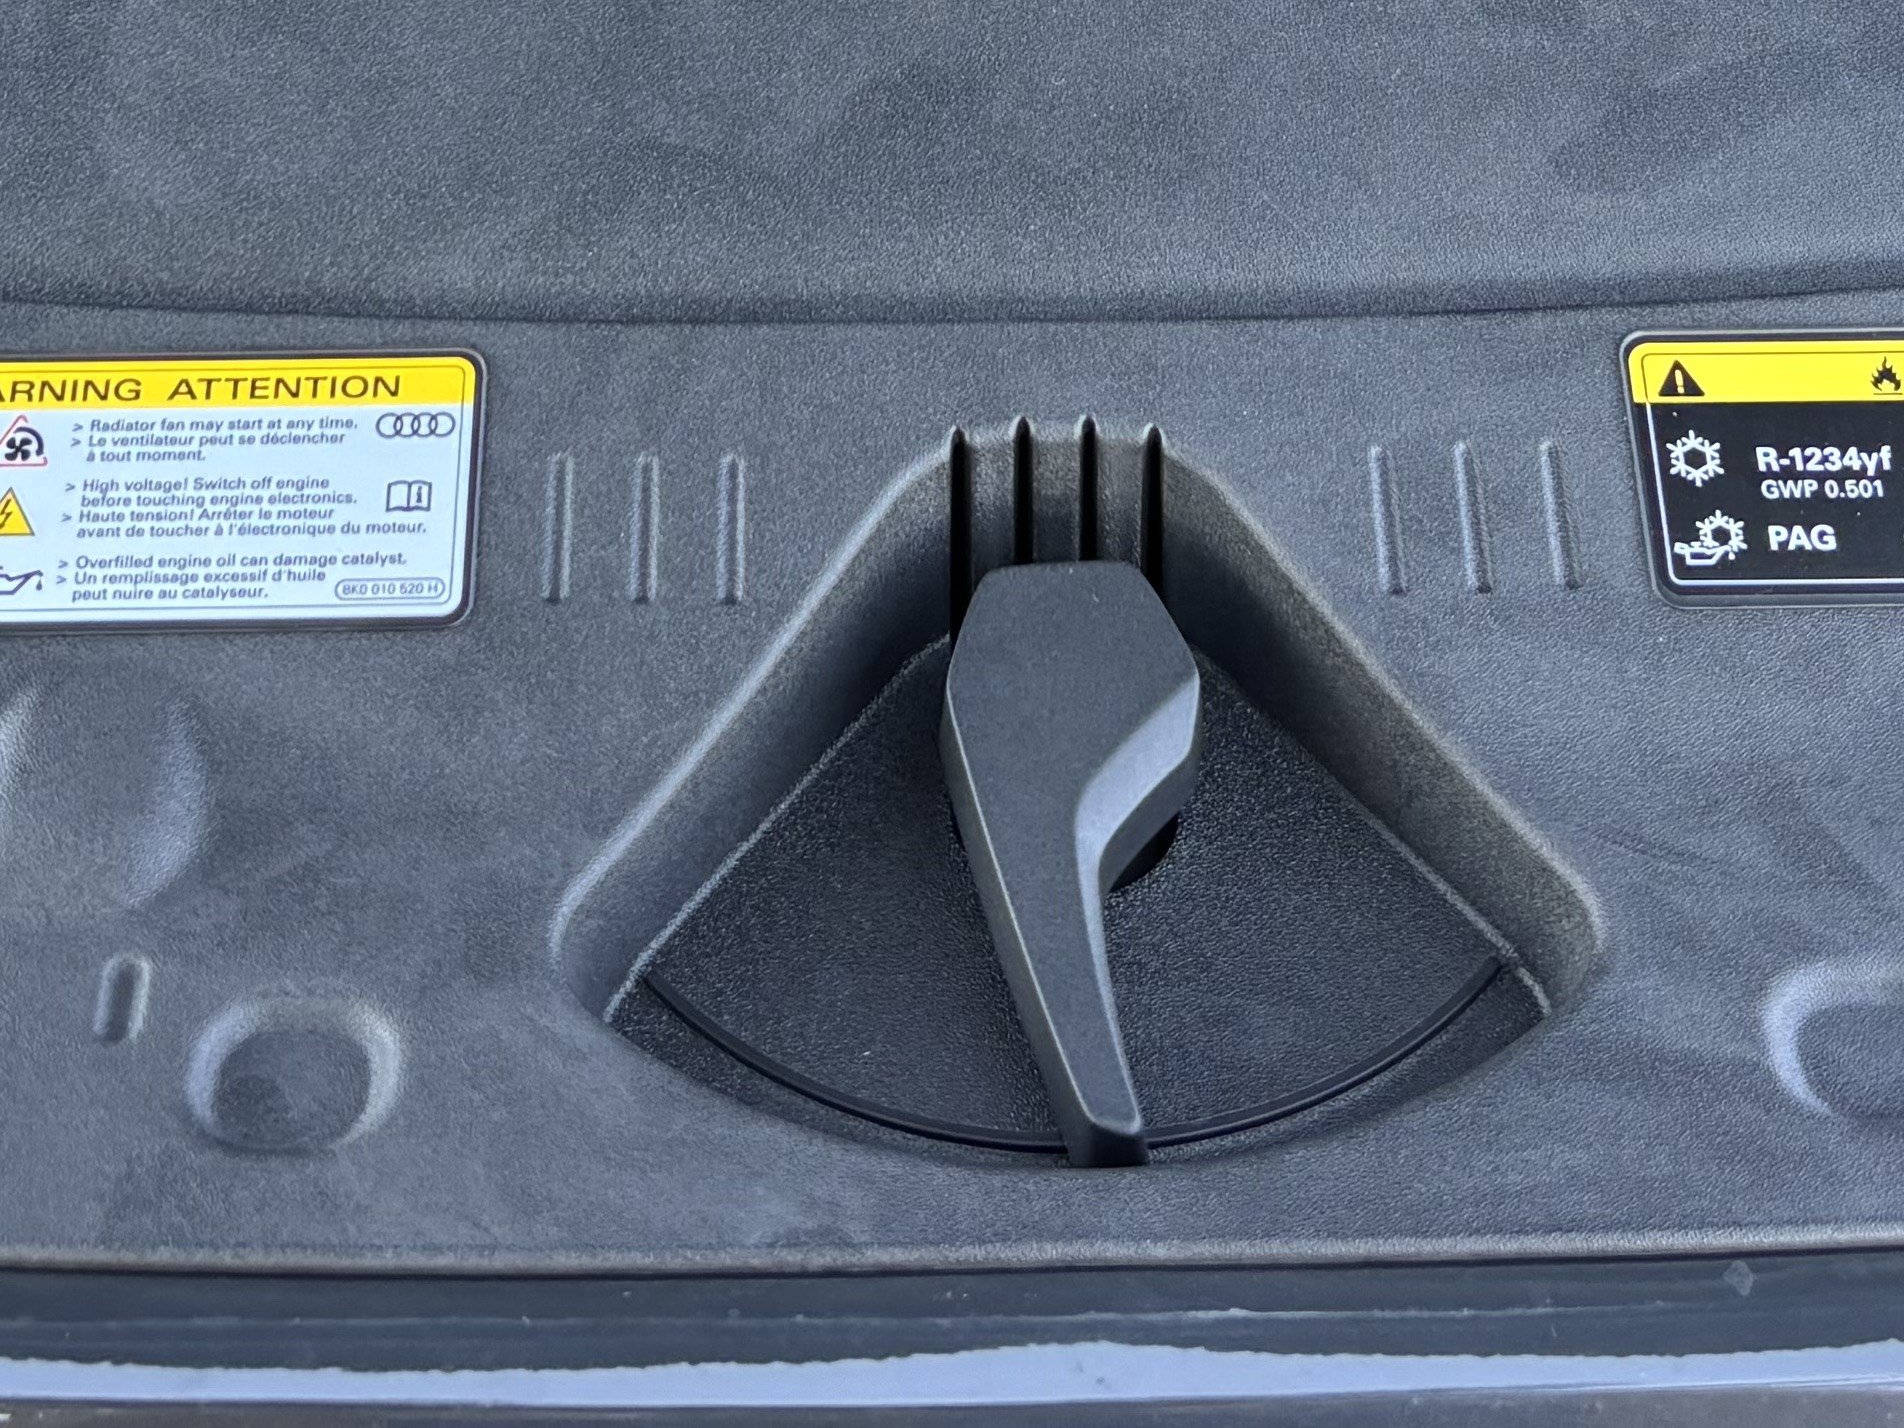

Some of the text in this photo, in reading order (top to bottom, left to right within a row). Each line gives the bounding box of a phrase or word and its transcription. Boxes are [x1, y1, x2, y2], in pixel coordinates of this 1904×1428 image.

[167, 375, 401, 401] ATTENTION
[90, 416, 358, 433] Radiator fan may start at any time.
[88, 432, 346, 448] Le ventilateur peut se déclencher
[99, 450, 132, 463] tout
[135, 449, 206, 462] moment.
[1756, 445, 1891, 476] R-1234yf
[82, 475, 330, 495] High voltage! Switch off engine
[1761, 481, 1819, 499] GWP
[1824, 480, 1884, 498] 0.501
[80, 490, 358, 508] before touching engine electronics.
[79, 506, 335, 523] Haute tension! Arrêter le moteur
[77, 526, 121, 538] avant
[125, 524, 145, 537] de
[150, 523, 210, 537] toucher
[214, 523, 224, 536] à
[340, 521, 361, 534] du
[365, 521, 427, 535] moteur.
[1768, 525, 1837, 551] PAG
[75, 551, 407, 570] Overfilled engine oil can damage catalyst.
[74, 571, 97, 585] Un
[102, 570, 199, 586] remplissage
[203, 569, 269, 583] excessif
[72, 585, 269, 603] peut nuire au catalyseur.
[371, 582, 396, 595] 010
